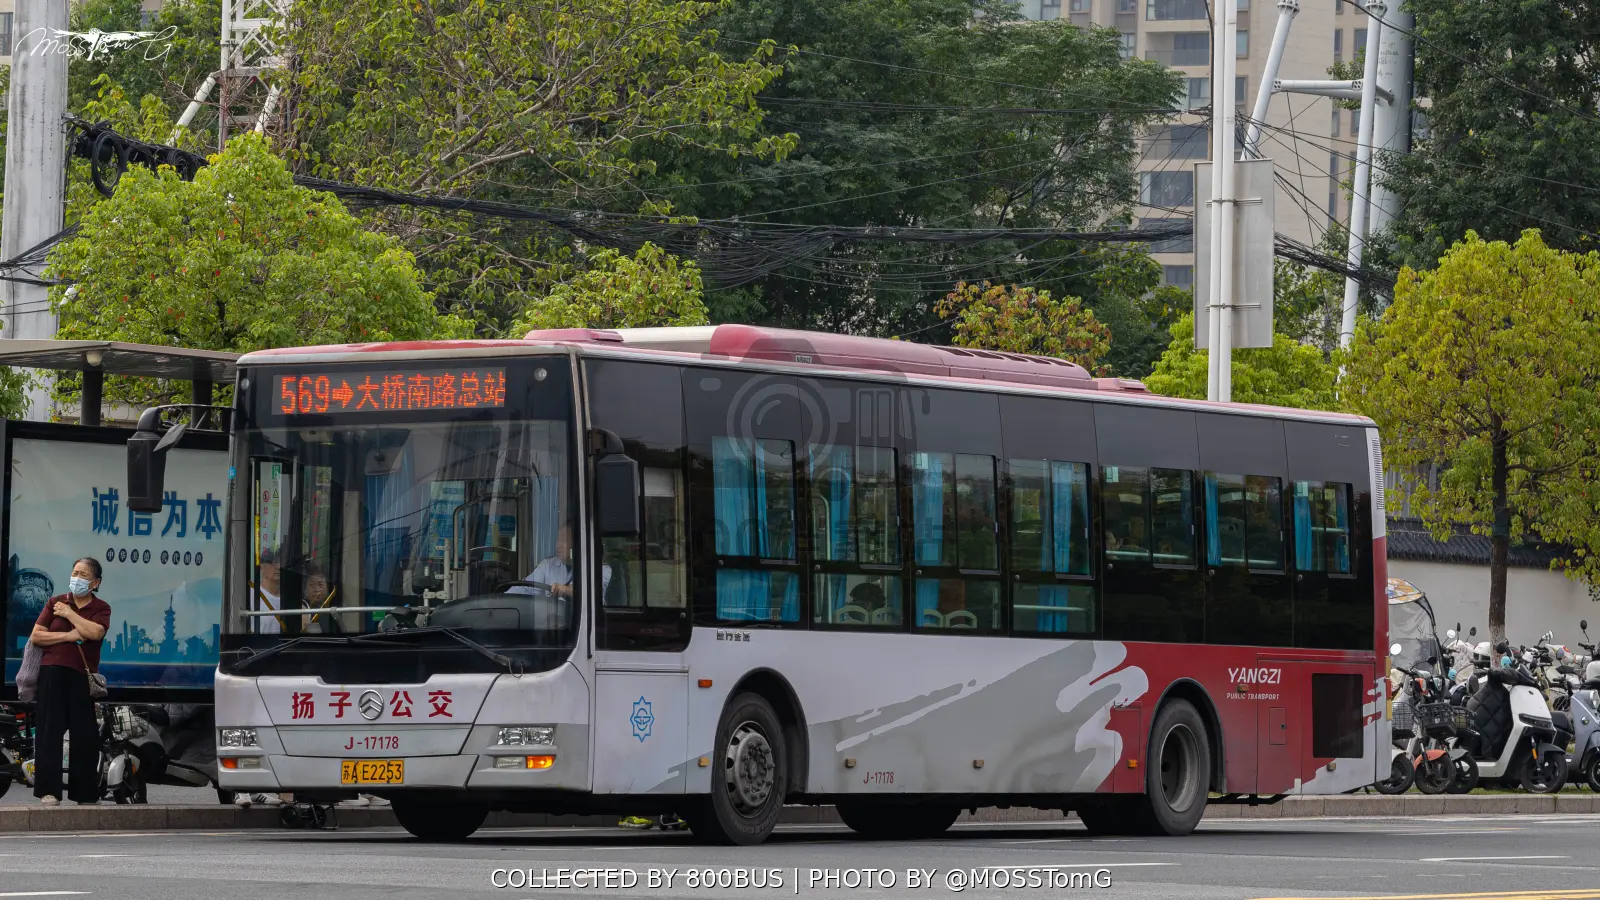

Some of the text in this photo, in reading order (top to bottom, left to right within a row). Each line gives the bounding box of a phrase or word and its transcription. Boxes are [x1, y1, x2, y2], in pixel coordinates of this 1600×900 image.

[281, 372, 506, 414] 569 大桥南路总站
[1227, 667, 1281, 684] YANGZI
[1226, 692, 1246, 700] PUBLIC
[292, 690, 453, 719] 扬子 公交
[343, 735, 399, 750] J-17178
[863, 771, 895, 784] J-17178
